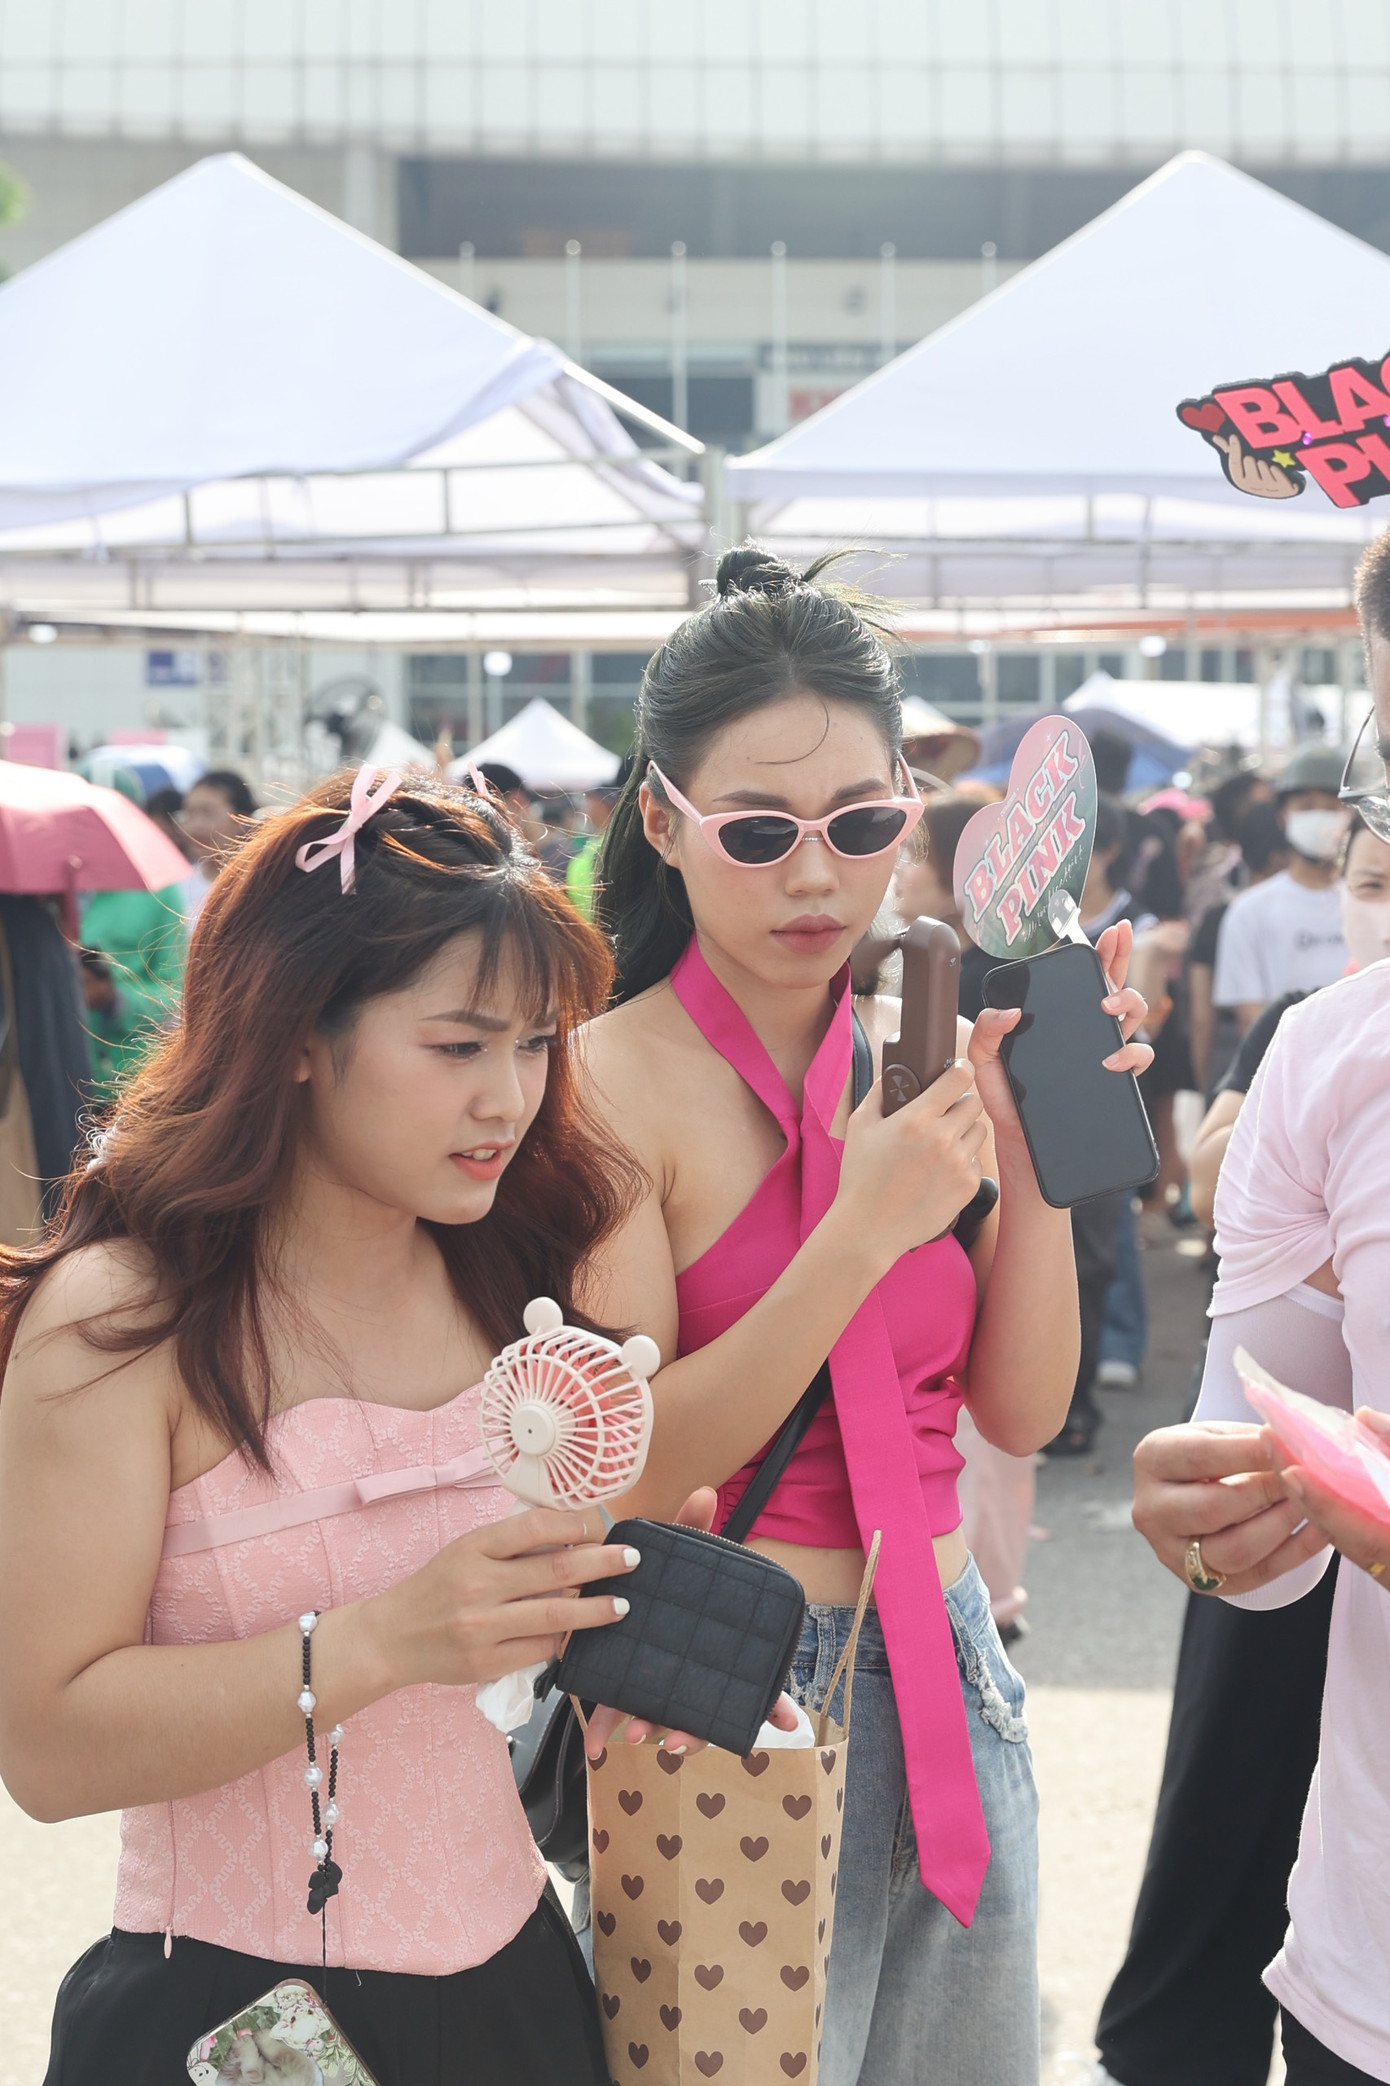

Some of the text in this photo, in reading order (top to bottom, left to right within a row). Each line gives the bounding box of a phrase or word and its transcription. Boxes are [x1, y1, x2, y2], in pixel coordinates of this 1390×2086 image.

[1214, 354, 1390, 449] BLA
[964, 730, 1079, 923] BLACK
[997, 792, 1085, 946] PINK
